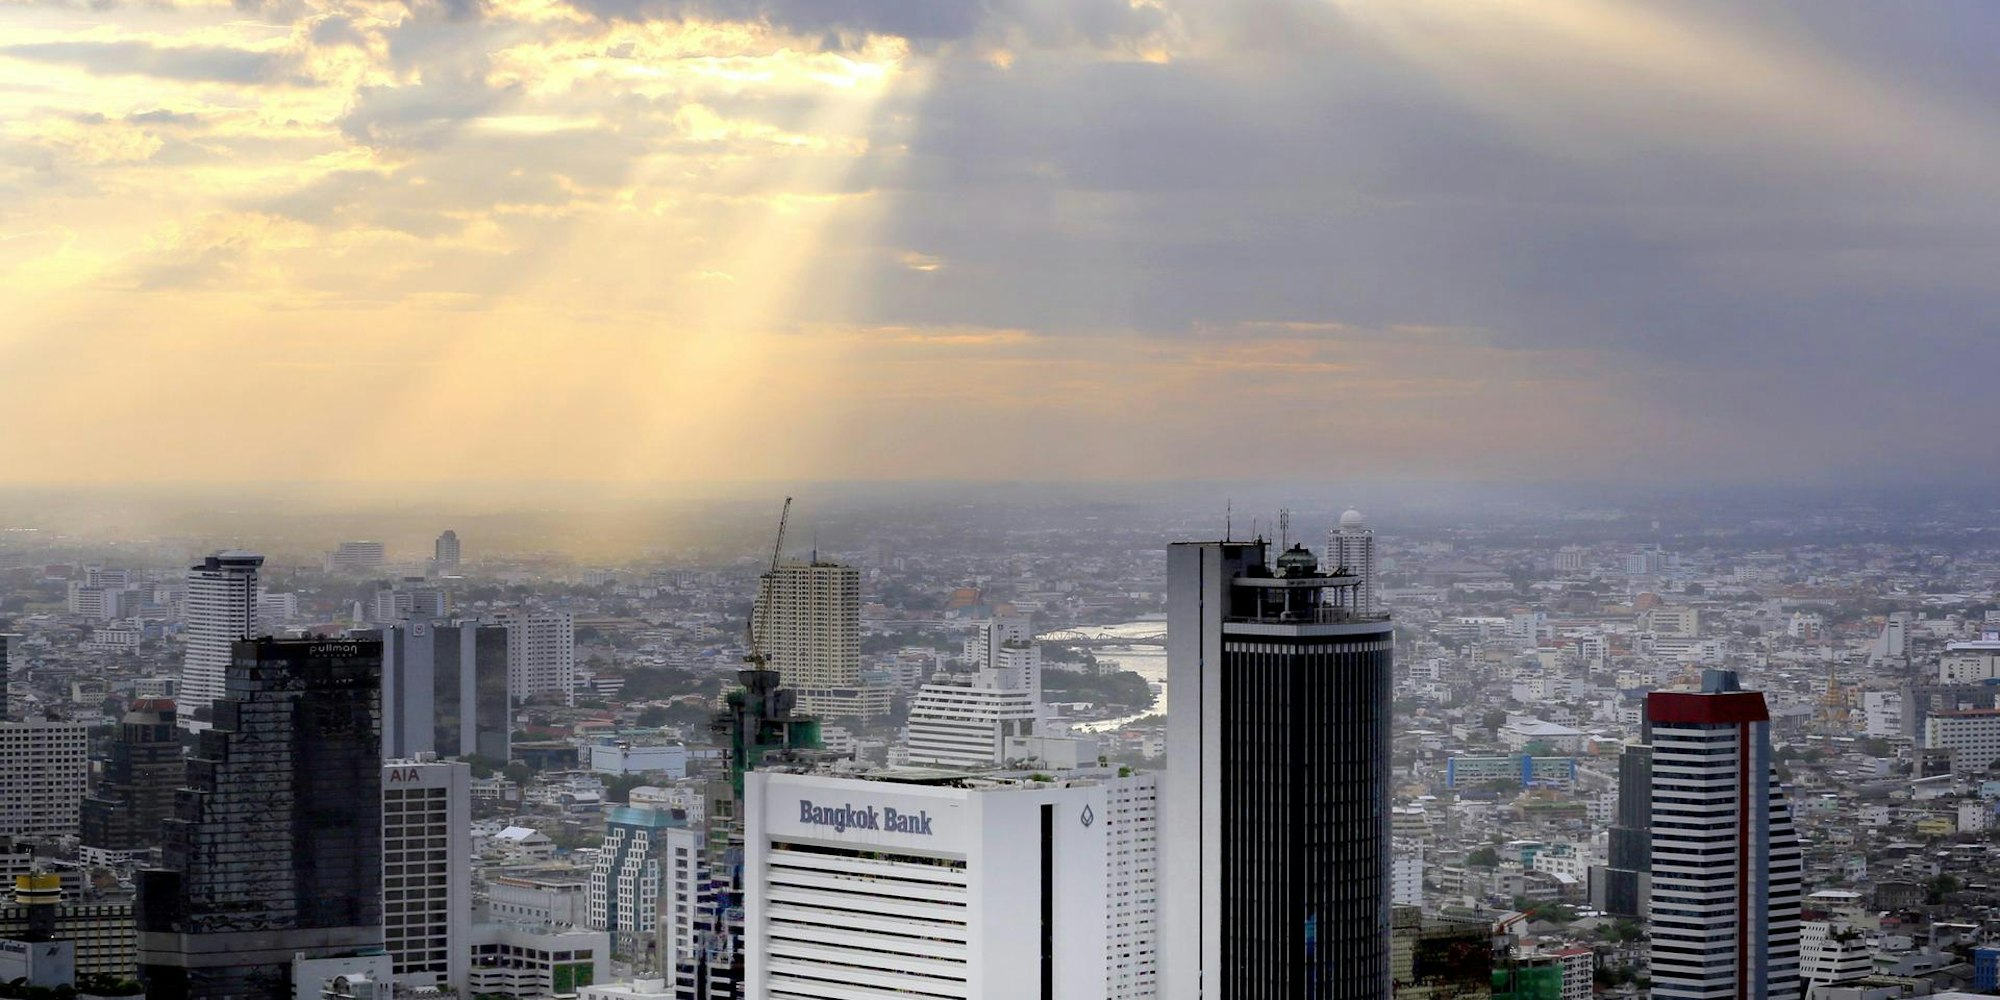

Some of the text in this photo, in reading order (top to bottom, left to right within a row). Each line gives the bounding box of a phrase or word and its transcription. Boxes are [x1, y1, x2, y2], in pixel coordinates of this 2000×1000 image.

[309, 644, 357, 655] pullman
[390, 768, 420, 782] AIA
[800, 800, 932, 835] Bangkok Bank
